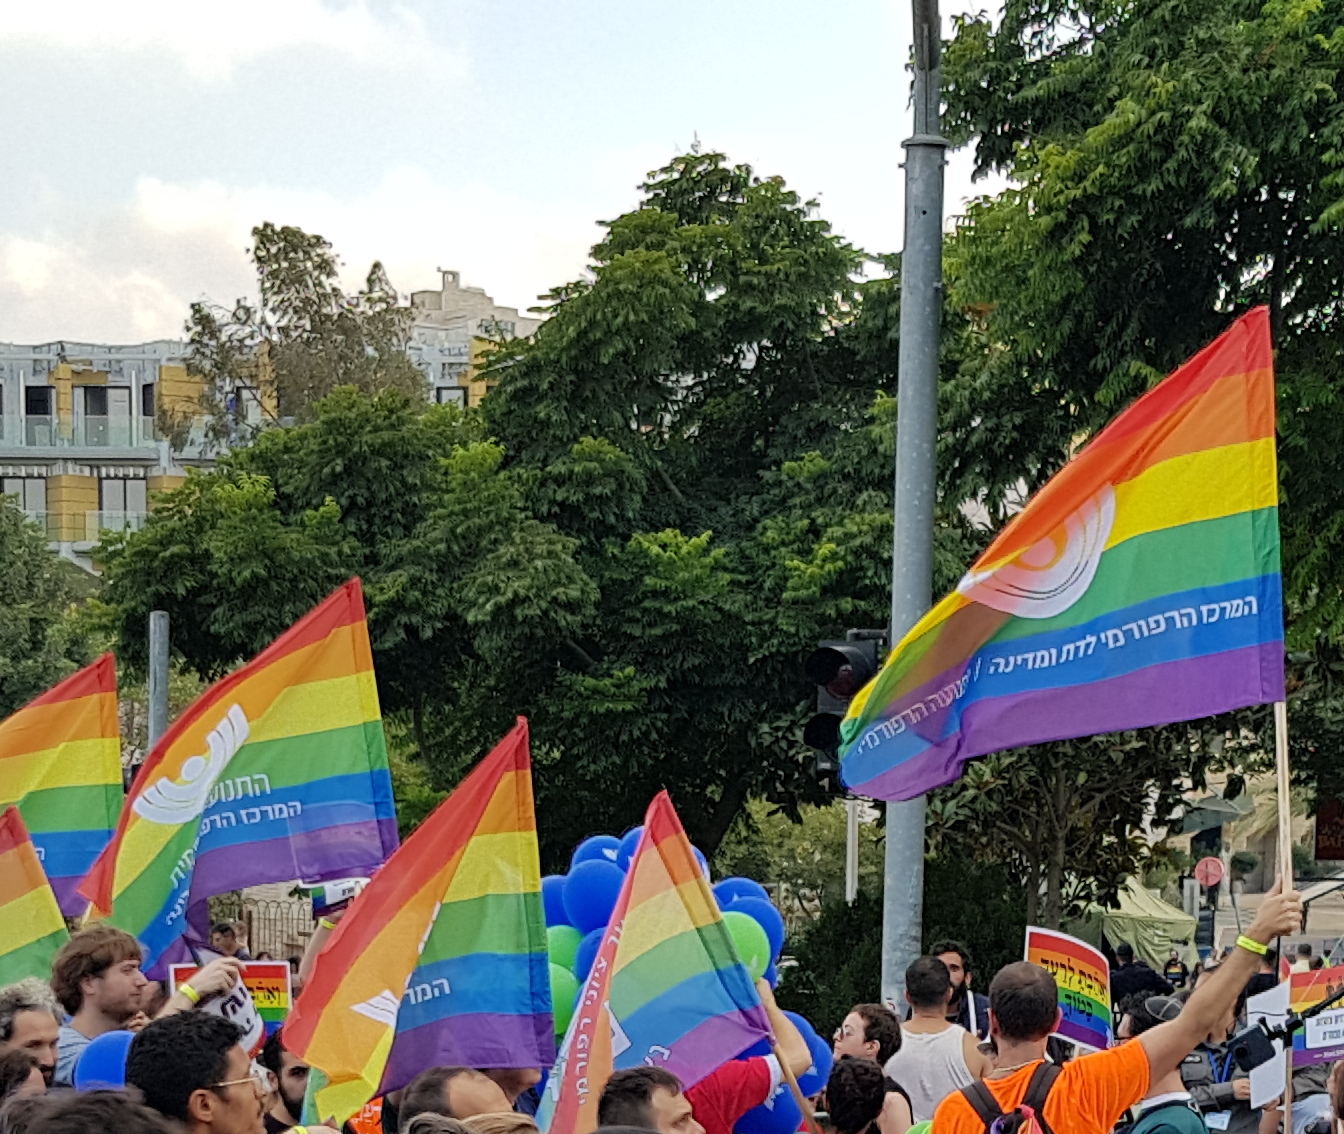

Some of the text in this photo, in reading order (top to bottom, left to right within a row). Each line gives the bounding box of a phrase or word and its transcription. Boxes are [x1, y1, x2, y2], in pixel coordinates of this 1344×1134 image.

[1199, 595, 1258, 625] המרכז
[1101, 604, 1198, 650] הרפורמי
[988, 648, 1057, 675] ומדינה
[1059, 634, 1098, 665] לדת
[239, 801, 302, 824] המרכז
